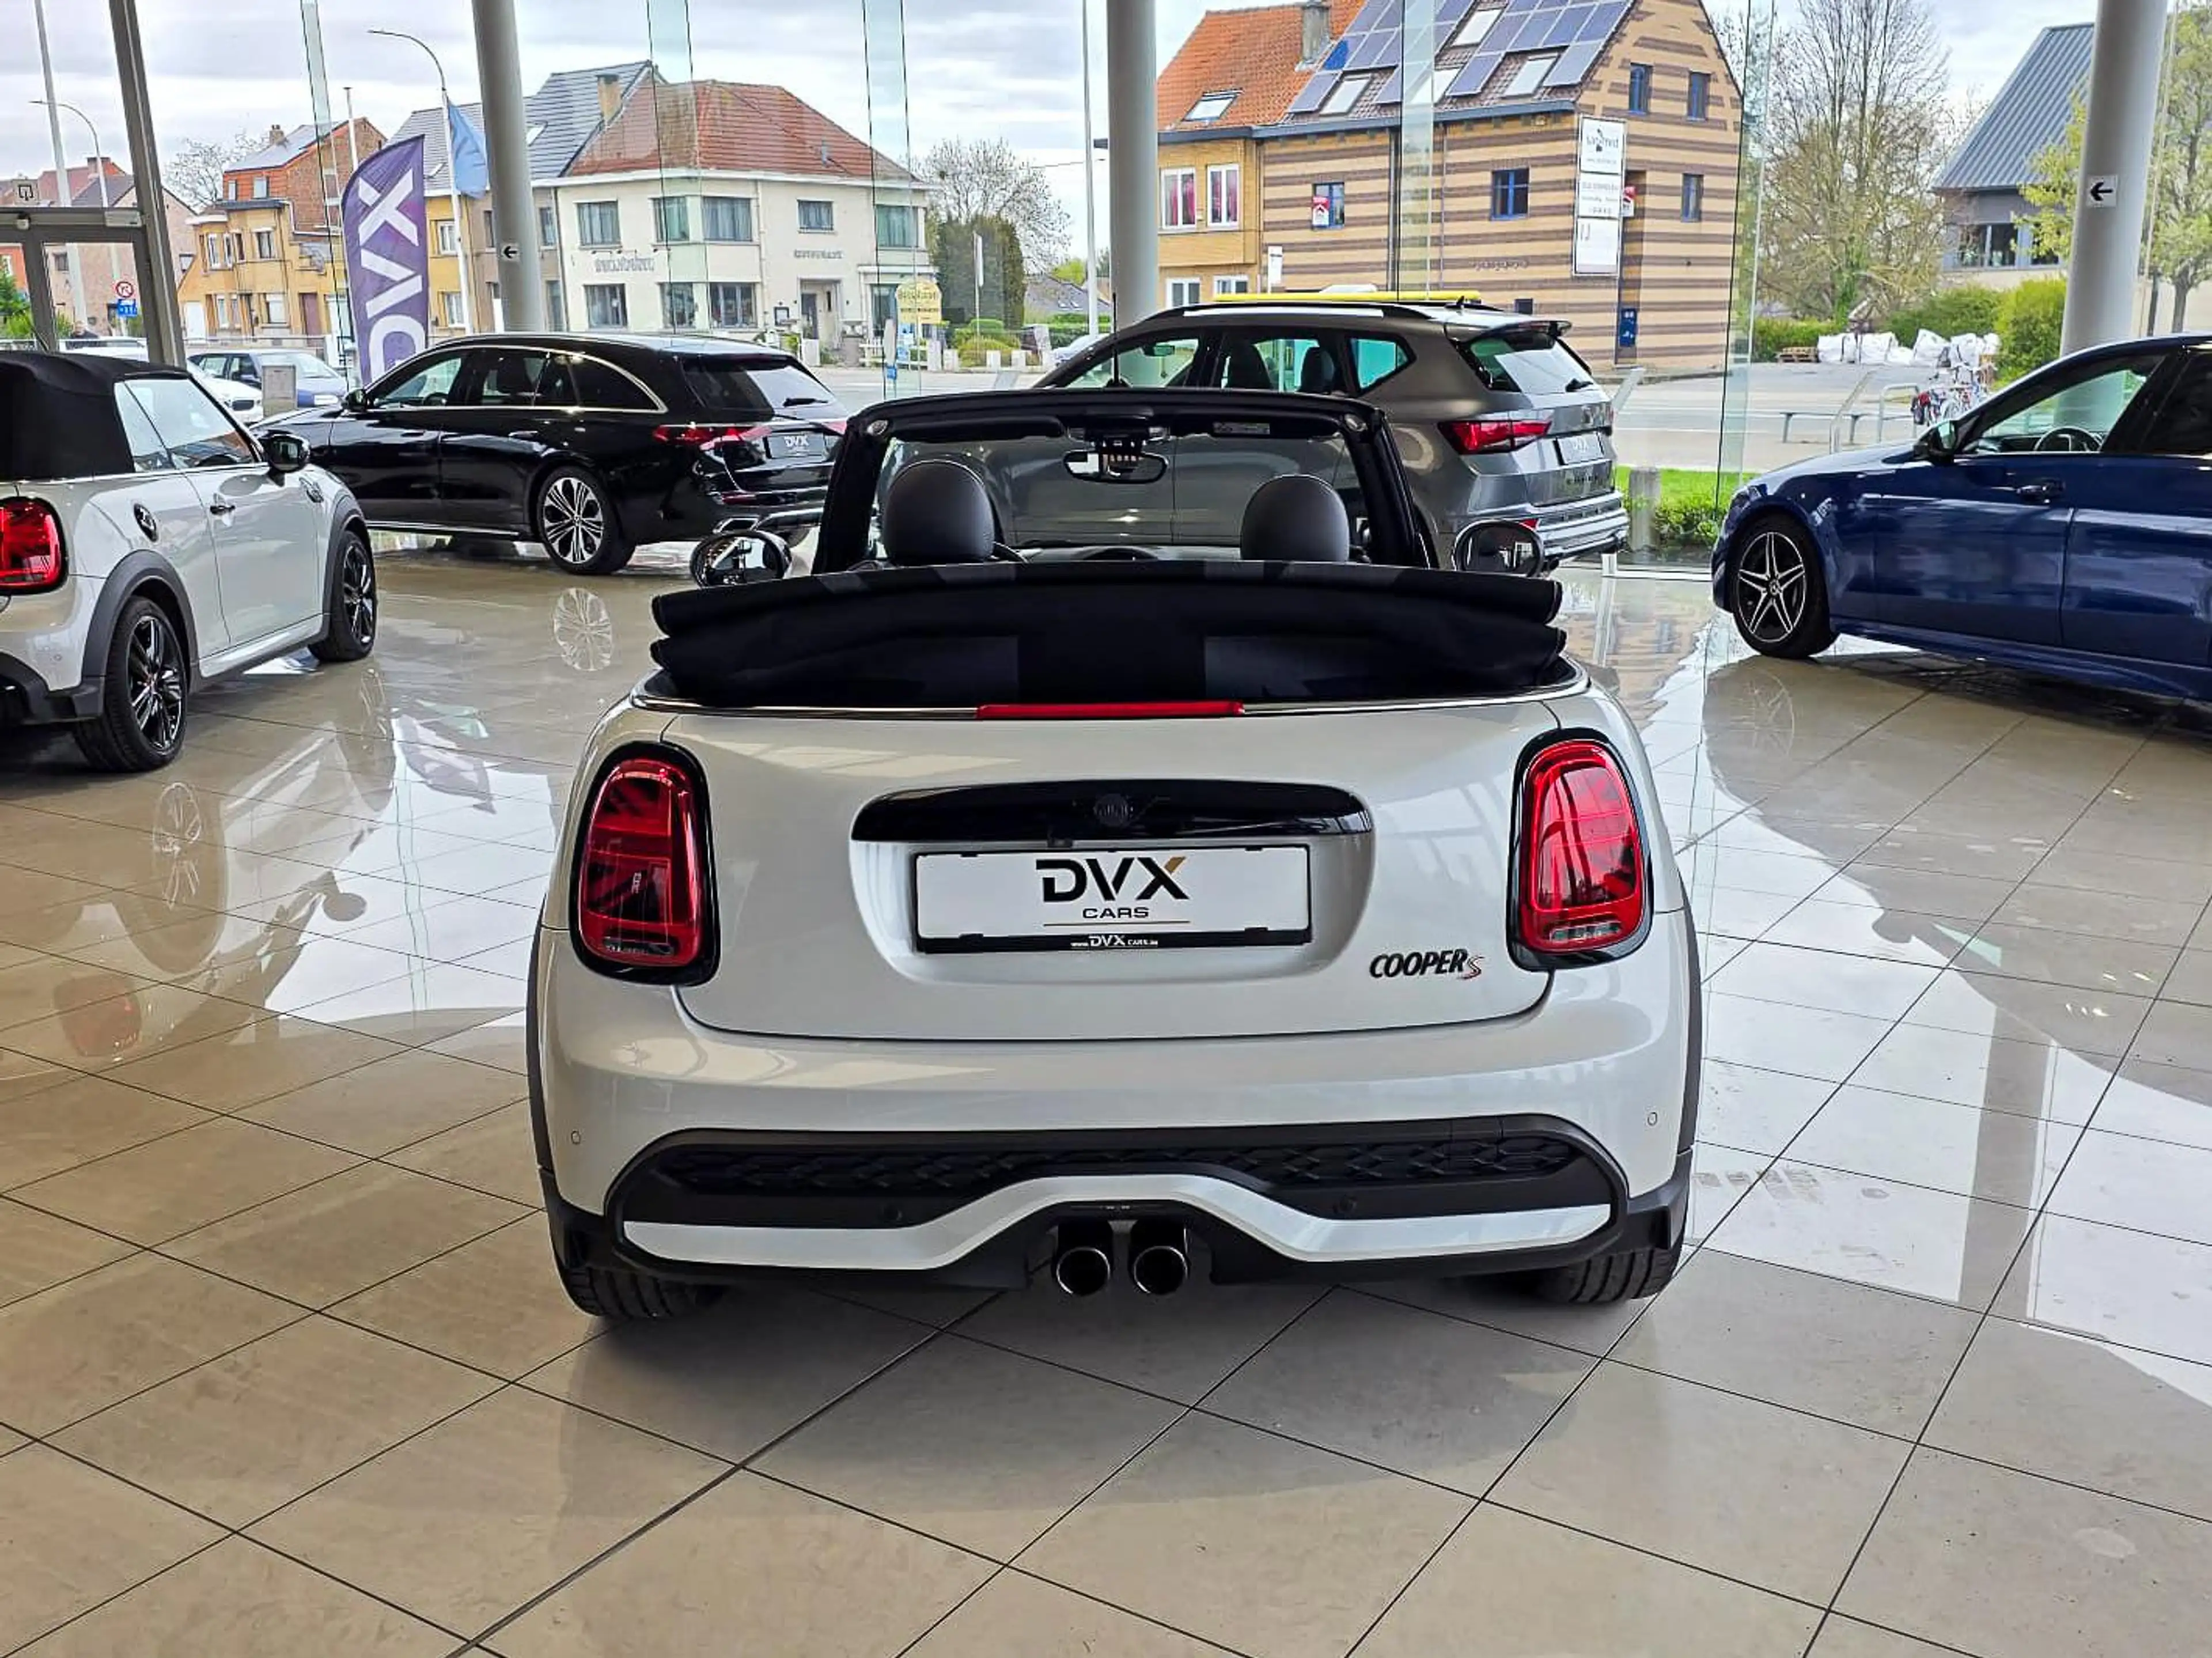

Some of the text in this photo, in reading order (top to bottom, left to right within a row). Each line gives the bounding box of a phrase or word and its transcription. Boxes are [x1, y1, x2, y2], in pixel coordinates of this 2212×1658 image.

[358, 169, 426, 382] DVX
[784, 436, 809, 447] DVX
[1036, 857, 1190, 902] DVX
[1082, 907, 1149, 919] CARS
[1369, 948, 1485, 979] COOPER S
